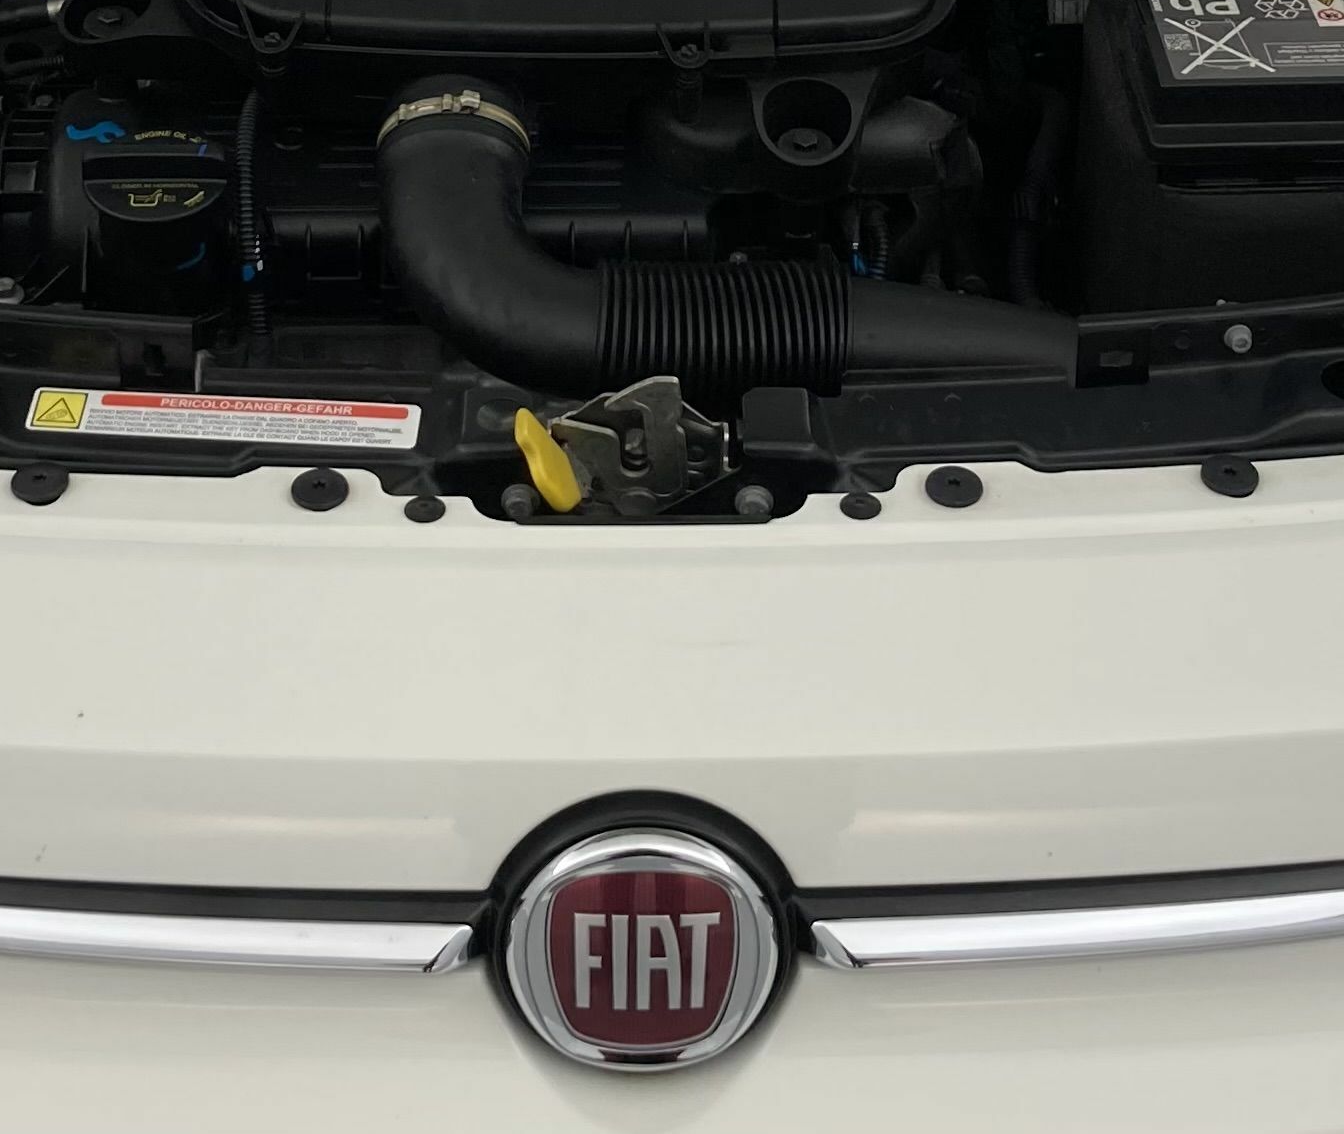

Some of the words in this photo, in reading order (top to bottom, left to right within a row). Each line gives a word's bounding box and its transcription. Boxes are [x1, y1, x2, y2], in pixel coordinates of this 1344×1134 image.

[134, 130, 172, 141] ENGINE
[160, 397, 353, 415] PERICOLO-DANGER-GEFAHR
[574, 911, 720, 1011] FIAT
